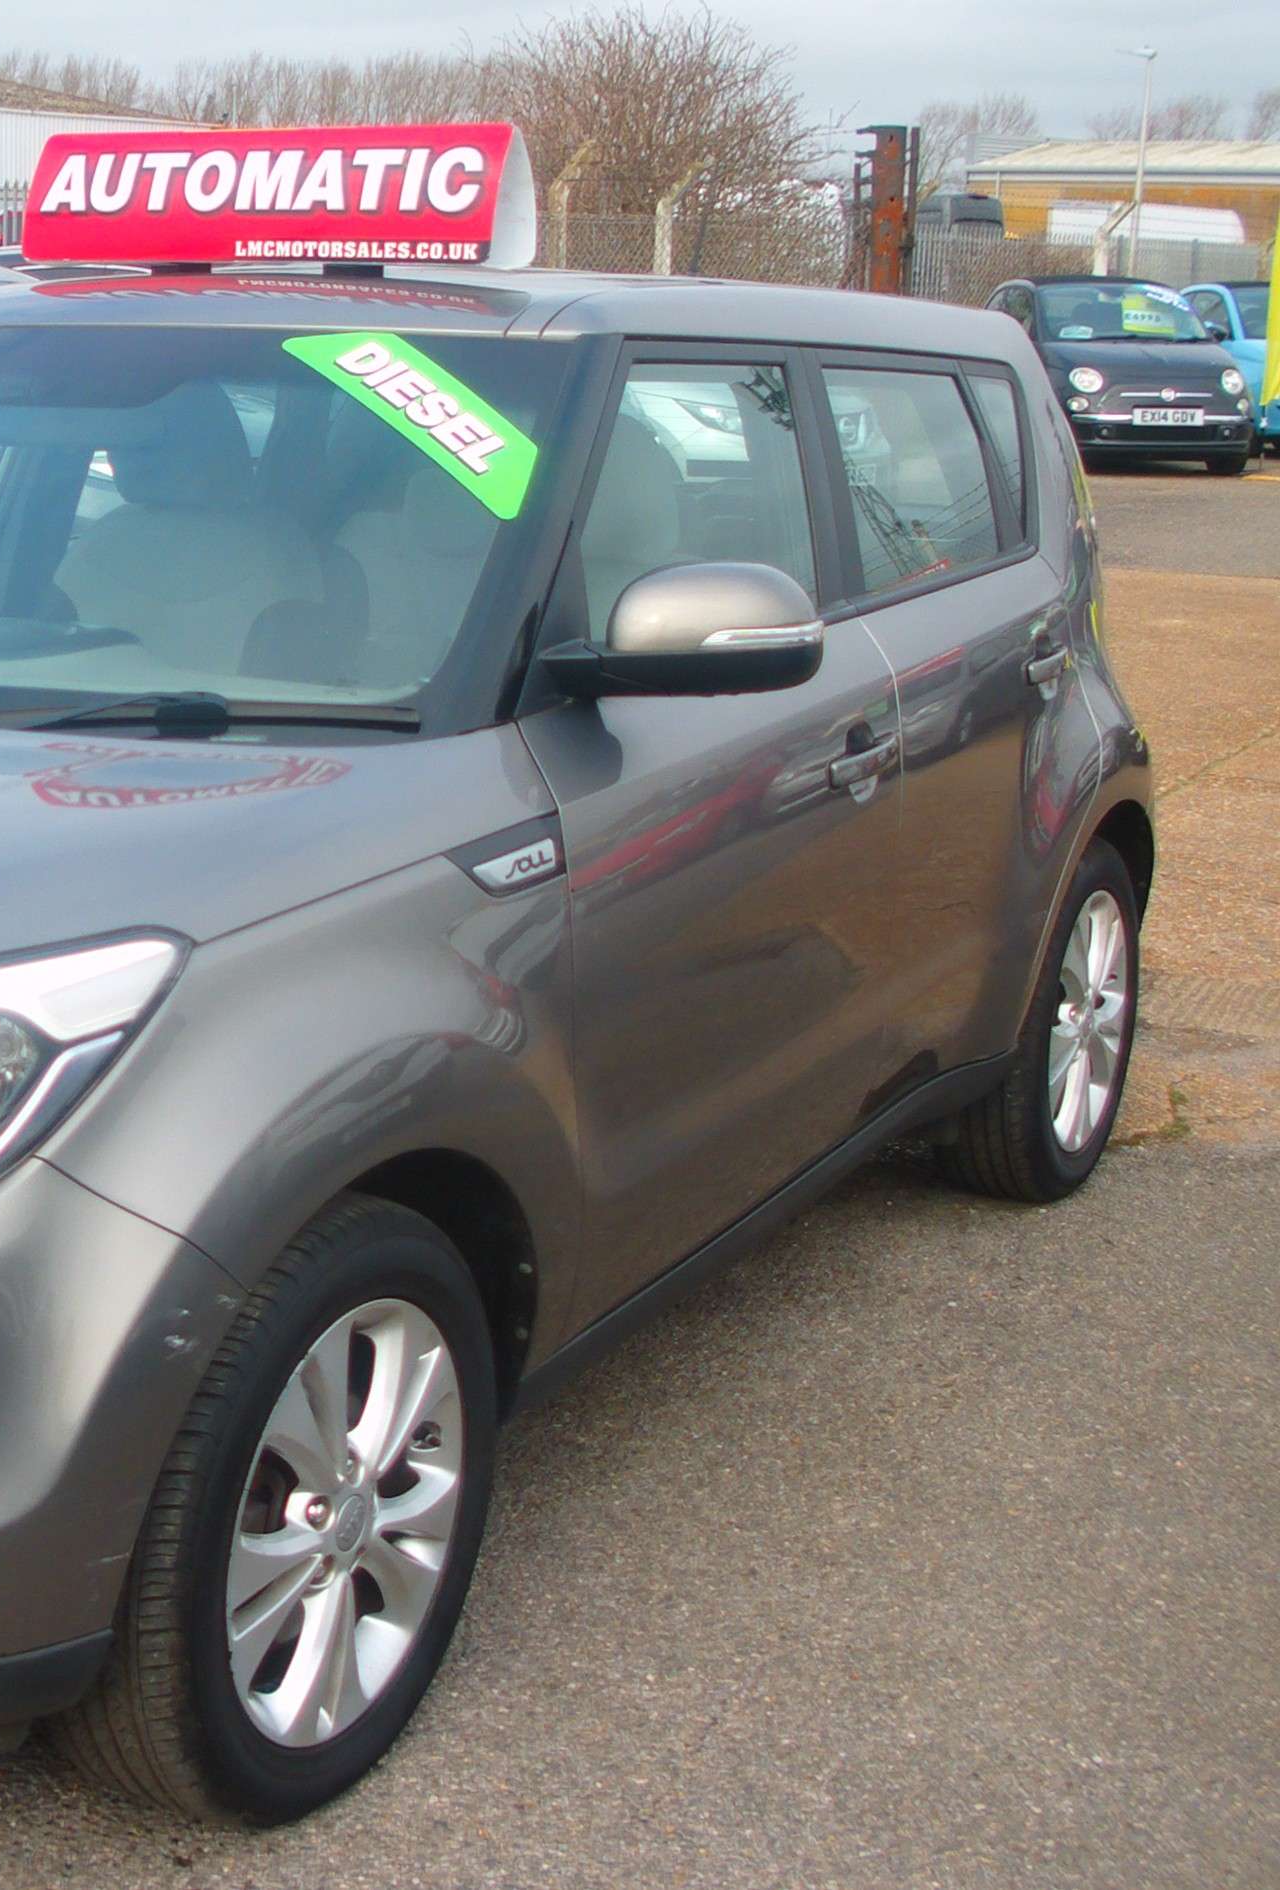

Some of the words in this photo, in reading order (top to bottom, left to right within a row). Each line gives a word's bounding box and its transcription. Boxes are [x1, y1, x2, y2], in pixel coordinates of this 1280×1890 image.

[39, 146, 486, 213] AUTOMATIC
[234, 240, 478, 261] LMCMOTORSALES.CO.UK
[333, 342, 505, 476] DIESEL
[1141, 410, 1168, 423] EX14
